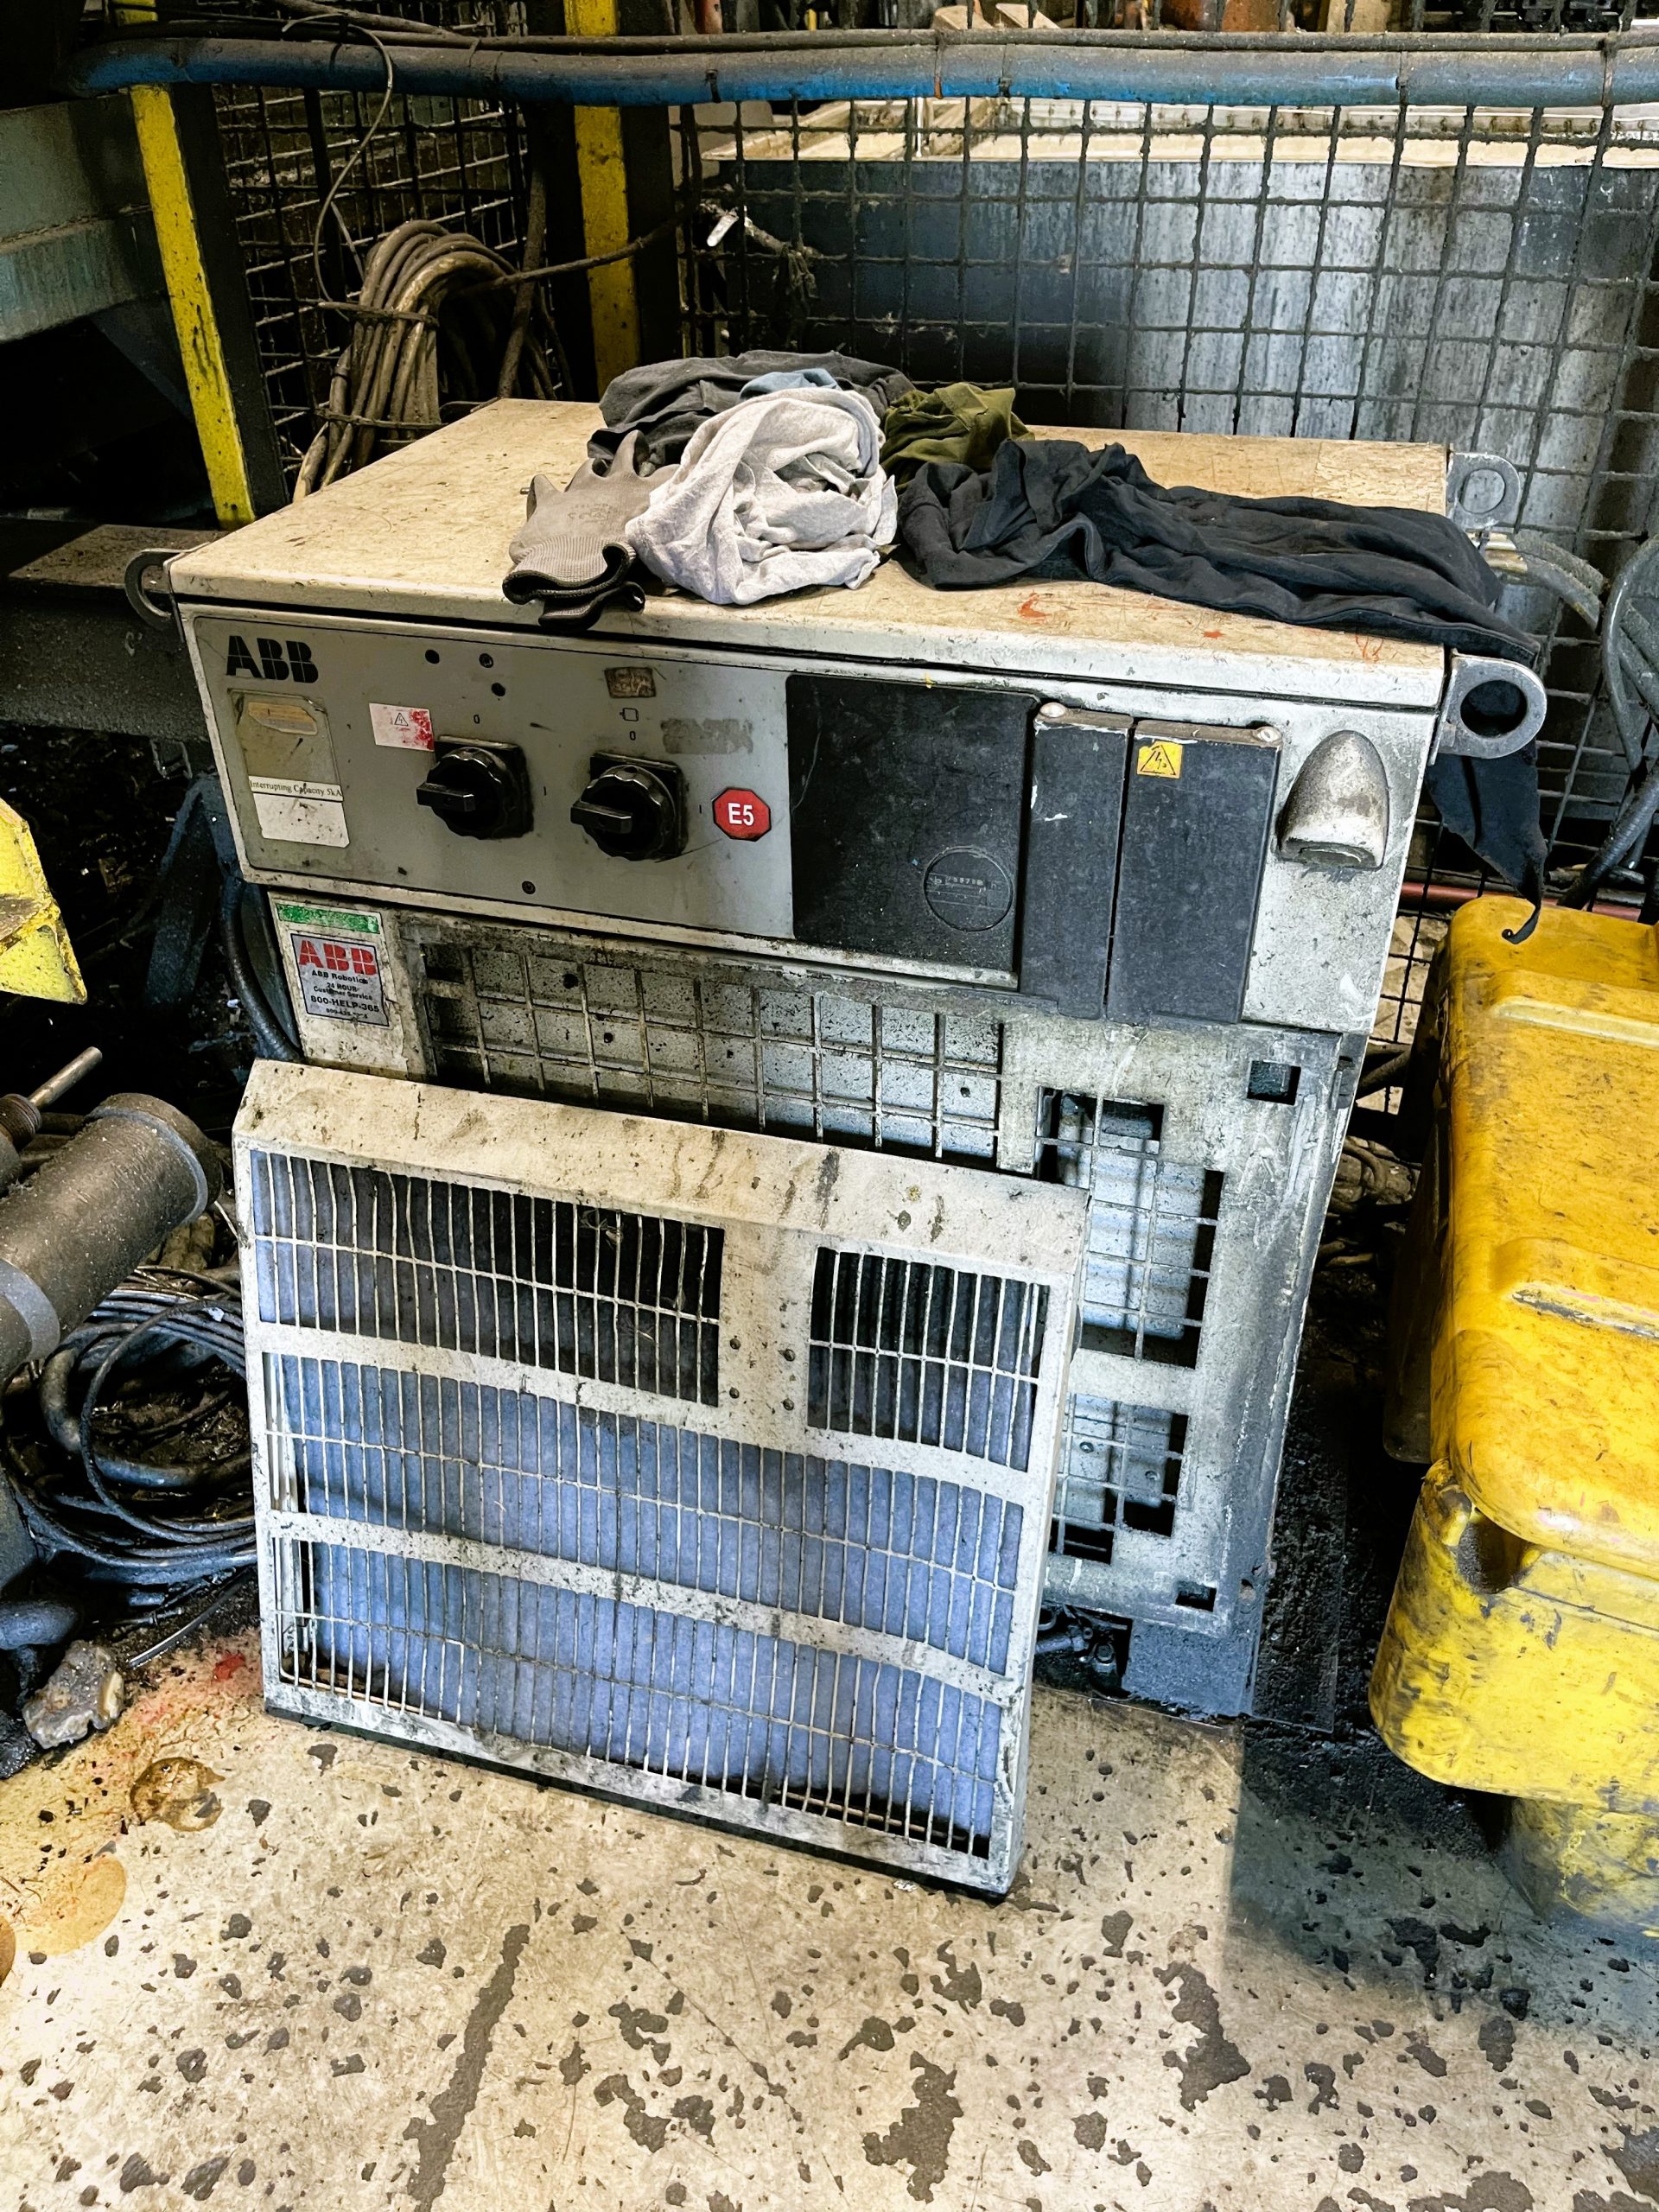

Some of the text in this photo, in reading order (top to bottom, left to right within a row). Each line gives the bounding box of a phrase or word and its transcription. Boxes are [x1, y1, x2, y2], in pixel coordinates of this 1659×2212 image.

[226, 635, 319, 683] ABB
[249, 779, 292, 793] Interrupting
[728, 802, 754, 826] E5
[299, 939, 377, 976] ABB
[312, 969, 329, 978] ABB
[314, 985, 346, 995] Custmer
[311, 995, 380, 1013] 800-HELP-365
